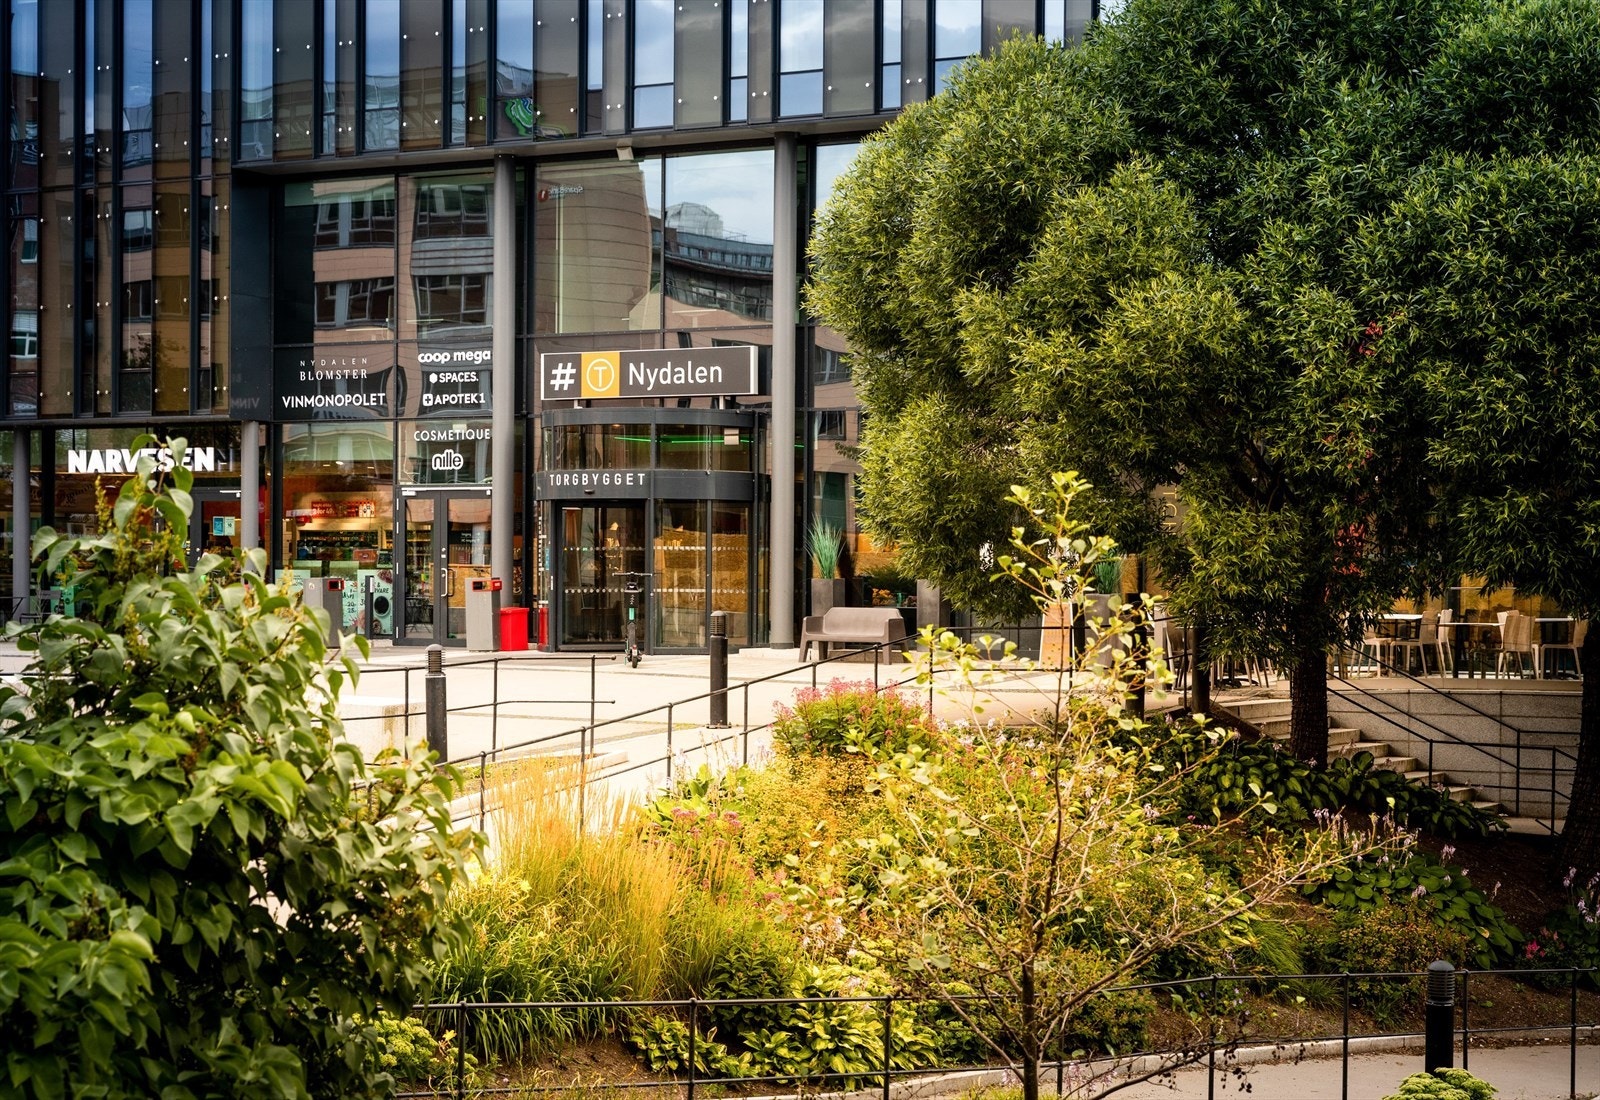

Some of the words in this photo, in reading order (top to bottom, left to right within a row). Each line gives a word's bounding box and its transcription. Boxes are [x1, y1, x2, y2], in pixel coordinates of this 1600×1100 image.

[300, 358, 367, 366] NYDALEN
[417, 352, 451, 364] coop
[453, 350, 491, 365] mega
[300, 368, 367, 381] BLOMSTER
[629, 360, 723, 391] Nydalen
[282, 393, 385, 408] VINMONOPOLET
[413, 428, 491, 442] COSMETIQUE
[433, 450, 462, 468] nille
[549, 473, 645, 486] TORGBYGGET
